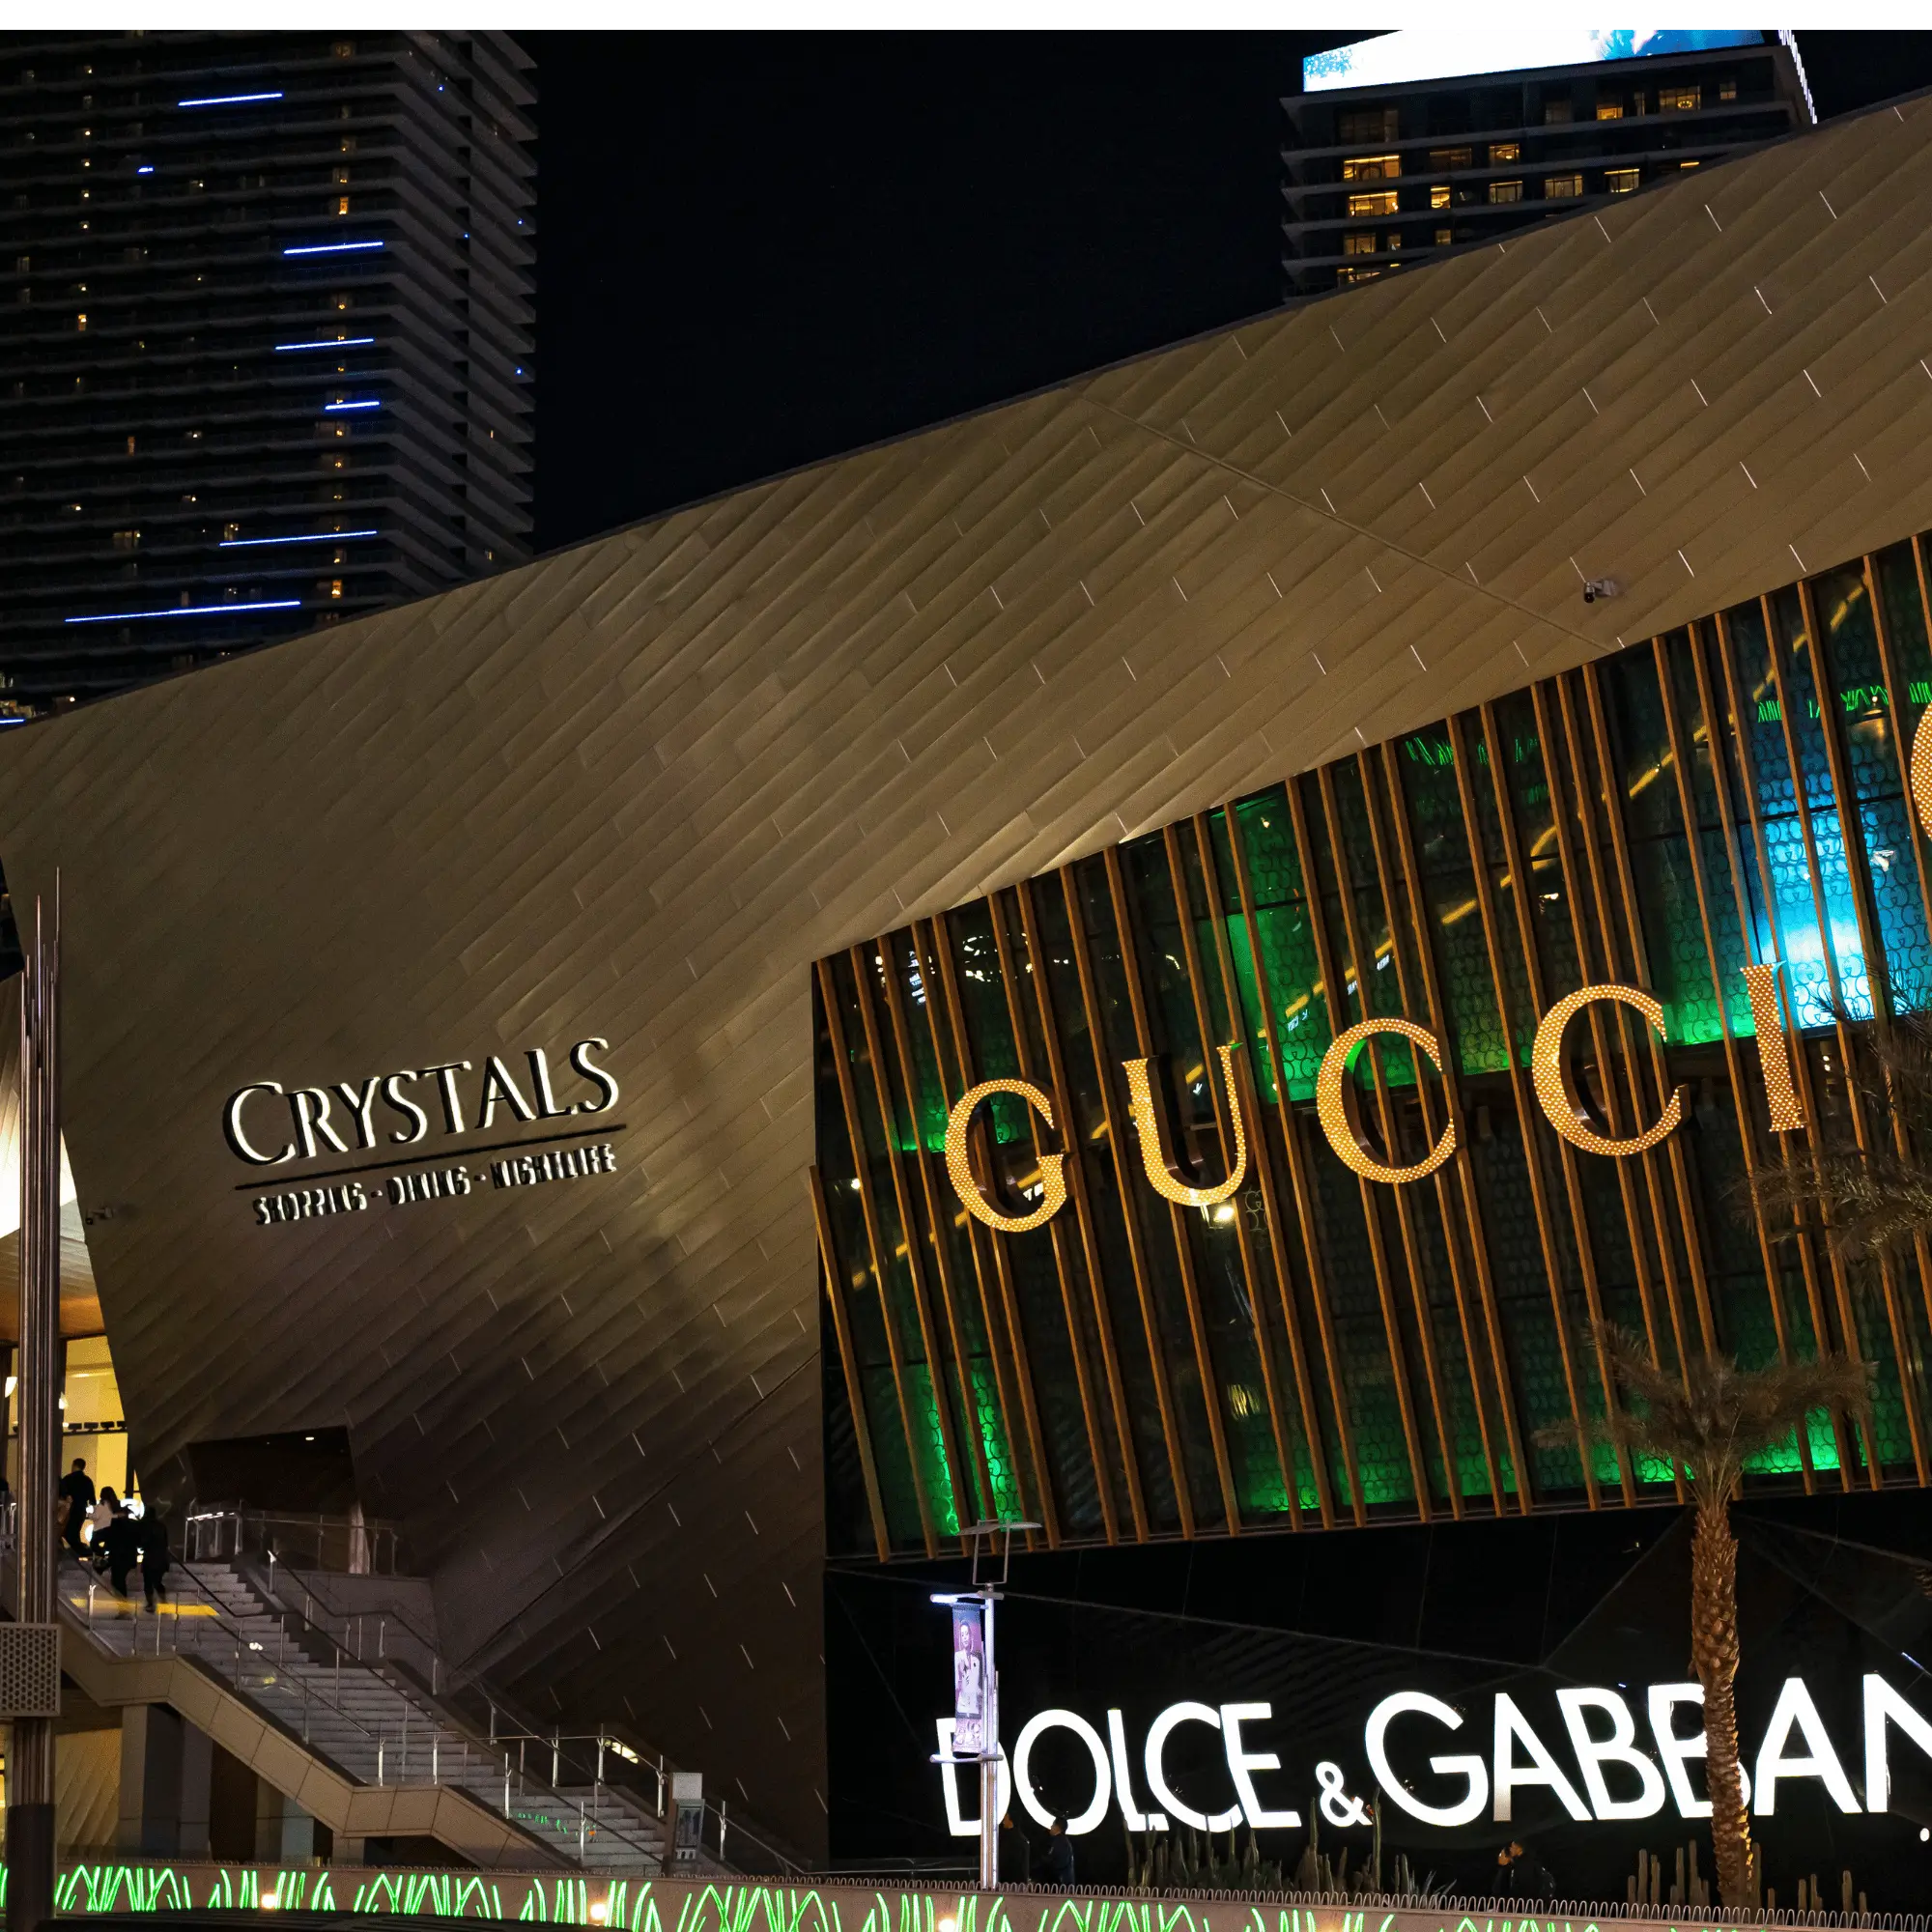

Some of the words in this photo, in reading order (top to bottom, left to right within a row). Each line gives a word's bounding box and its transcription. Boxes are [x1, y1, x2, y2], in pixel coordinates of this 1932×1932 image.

[222, 1037, 619, 1165] CRYSTALS
[944, 963, 1805, 1232] GUCCI
[252, 1182, 367, 1225] SHOPPING
[386, 1166, 470, 1206] DINING
[490, 1143, 617, 1189] NIGHTLIFE
[936, 1701, 1302, 1836] DOLCE
[1315, 1761, 1373, 1828] &
